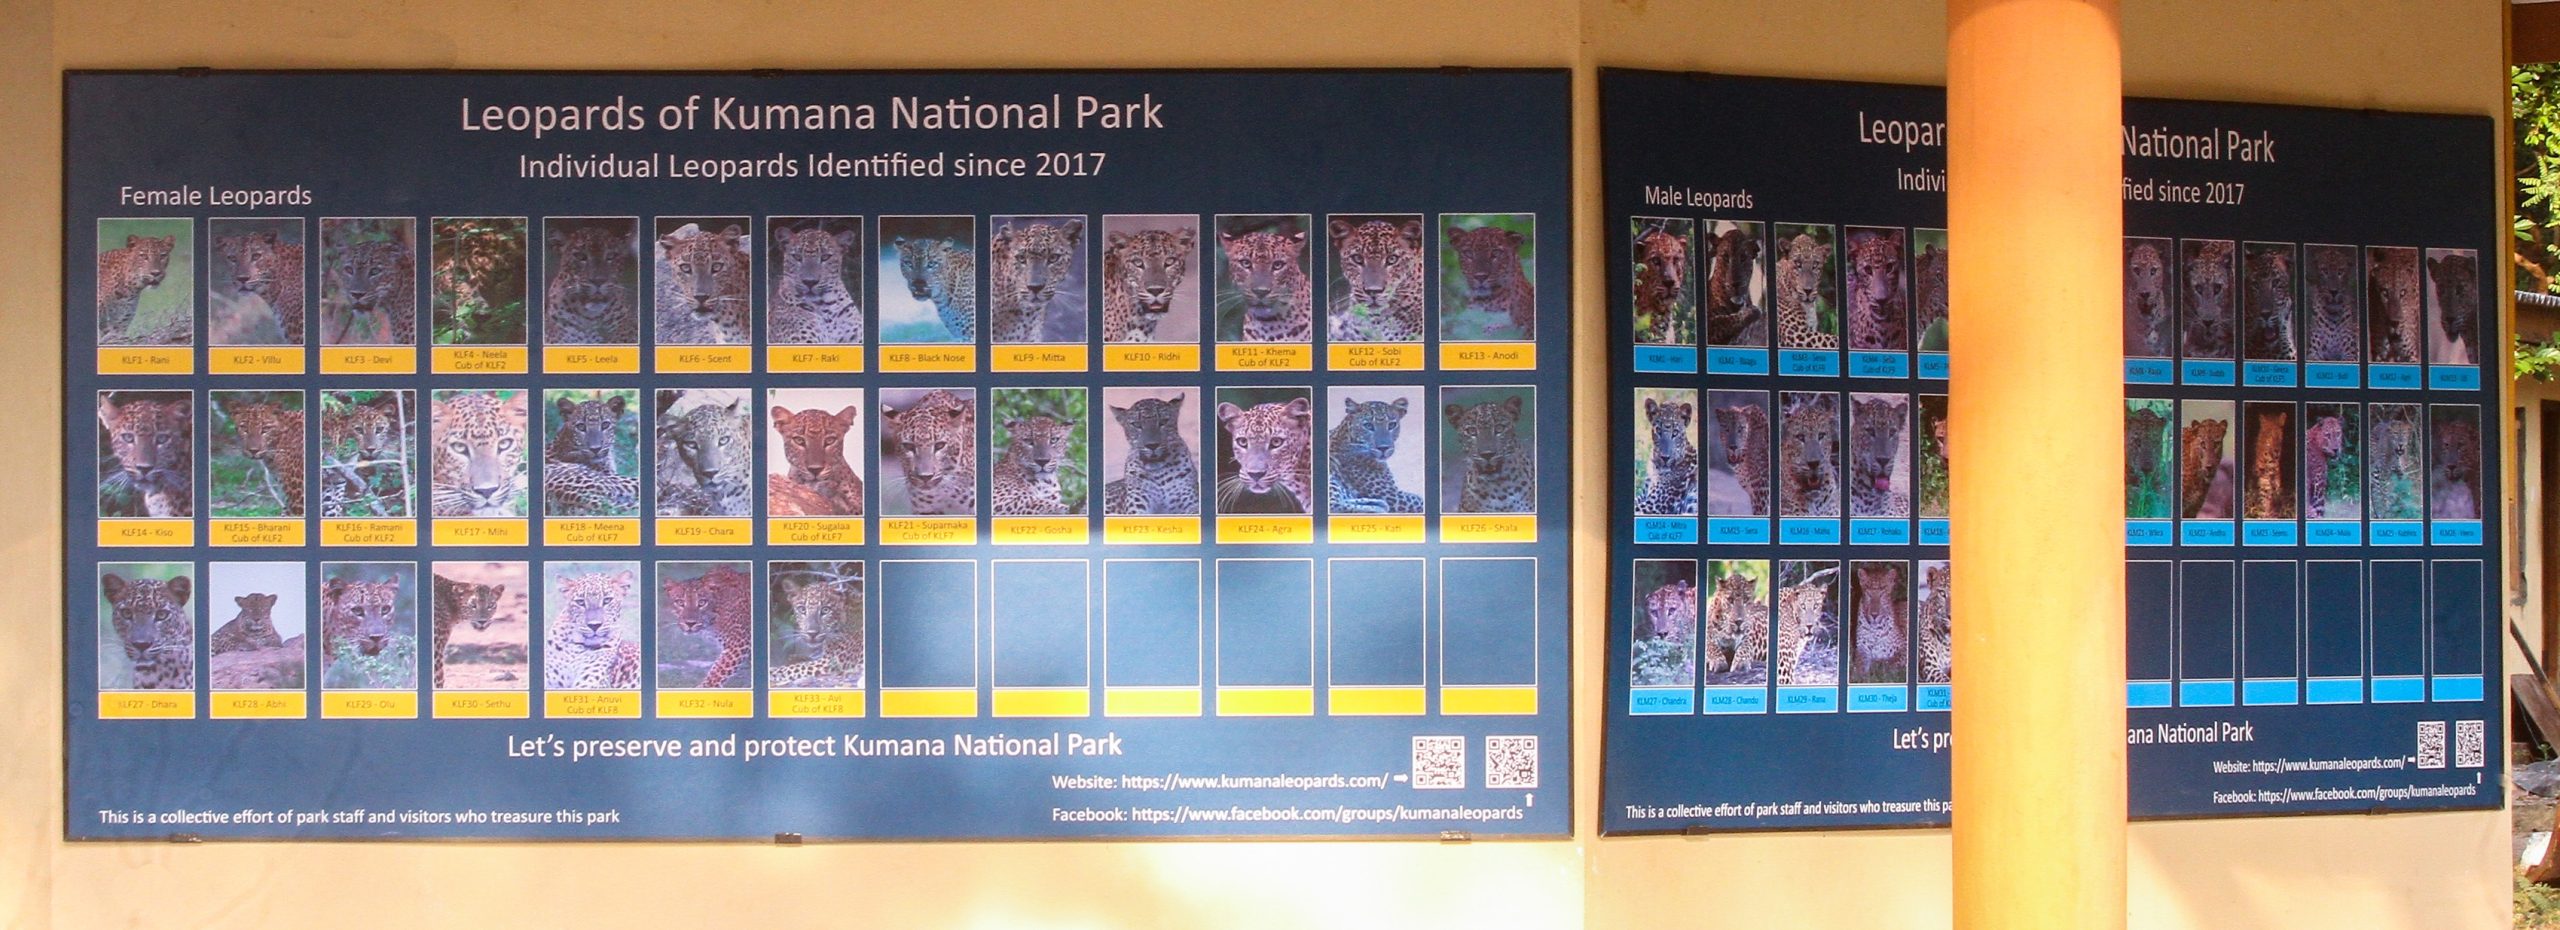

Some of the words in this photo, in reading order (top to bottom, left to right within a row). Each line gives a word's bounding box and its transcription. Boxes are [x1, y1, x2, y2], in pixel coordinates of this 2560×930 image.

[463, 96, 644, 139] Leopards
[659, 95, 700, 130] of
[714, 97, 874, 130] Kumana
[892, 94, 1059, 129] National
[1078, 93, 1163, 128] Park
[1859, 111, 1945, 153] Leopar
[2121, 125, 2219, 160] National
[2228, 130, 2275, 163] Park
[521, 153, 658, 178] Individual
[670, 152, 798, 183] Leopards
[809, 152, 943, 177] Identified
[954, 153, 1026, 177] since
[1036, 153, 1105, 176] 2017
[1898, 168, 1945, 192] Indivi
[2159, 180, 2200, 203] since
[2206, 182, 2244, 205] 2017
[122, 185, 202, 205] Female
[210, 185, 312, 210] Leopards
[1646, 185, 1682, 206] Male
[1687, 187, 1753, 211] Leopards
[454, 350, 474, 359] KLF4
[1232, 348, 1258, 356] KLF11
[1266, 348, 1296, 356] Khema
[1348, 347, 1374, 356] KLF12
[1382, 347, 1401, 355] Sobi
[1459, 351, 1485, 360] KLF13
[1492, 352, 1519, 360] Anodi
[122, 356, 142, 364] KLF1
[150, 356, 170, 364] Rani
[233, 355, 254, 364] KLF2
[345, 355, 365, 364] KLF3
[373, 355, 392, 364] Devi
[567, 355, 587, 363] KLF5
[595, 355, 618, 363] Leela
[679, 354, 700, 363] KLF6
[707, 354, 732, 363] Scent
[792, 354, 813, 363] KLF7
[821, 354, 840, 362] Raki
[889, 353, 910, 362] KLF8
[918, 354, 940, 362] Black
[943, 354, 965, 362] Nose
[1013, 353, 1034, 362] KLF9
[1042, 353, 1066, 362] Mitta
[1124, 352, 1151, 361] KLF10
[1158, 352, 1180, 361] Ridhi
[455, 361, 472, 369] Cub
[474, 361, 483, 369] of
[486, 361, 506, 369] KLF2
[1238, 358, 1256, 367] Cub
[1258, 358, 1267, 367] of
[1269, 358, 1290, 367] KLF2
[1349, 358, 1367, 366] Cub
[1368, 358, 1378, 366] of
[1380, 358, 1400, 366] KLF2
[224, 524, 250, 532] KLF15
[258, 524, 291, 532] Bharani
[336, 523, 362, 532] KLF16
[370, 523, 403, 532] Ramani
[560, 523, 586, 531] KLF18
[594, 523, 625, 531] Meena
[675, 527, 701, 536] KLF19
[708, 527, 734, 535] Chara
[783, 522, 809, 530] KLF20
[817, 522, 850, 532] Sugalaa
[1238, 525, 1264, 533] KLF24
[1272, 525, 1292, 535] Agra
[121, 528, 147, 537] KLF14
[155, 529, 173, 537] Kiso
[232, 534, 249, 543] Cub
[251, 534, 260, 542] of
[263, 534, 283, 542] KLF2
[2128, 728, 2153, 744] ana
[2158, 721, 2217, 743] National
[2223, 720, 2253, 742] Park
[573, 740, 681, 762] preserve
[690, 734, 735, 757] and
[745, 736, 836, 762] protect
[845, 734, 944, 756] Kumana
[955, 733, 1058, 756] National
[1069, 732, 1122, 755] Park
[2213, 760, 2251, 773] Website:
[2253, 755, 2406, 775] https://www.kumanaleopards.com/
[1052, 774, 1117, 789] Website:
[1122, 772, 1389, 791] https://www.kumanaleopards.com/
[2213, 790, 2256, 803] Facebook:
[2258, 783, 2476, 804] https://www.facebook.com/groups/kumanaleopards
[1626, 805, 1646, 818] This
[1648, 805, 1656, 818] is
[1658, 808, 1664, 818] a
[1666, 804, 1713, 818] collective
[1714, 803, 1742, 817] effort
[1744, 802, 1755, 816] of
[1756, 802, 1778, 819] park
[1780, 801, 1802, 815] staff
[1803, 801, 1822, 814] and
[1823, 801, 1857, 814] visitors
[1859, 800, 1880, 813] who
[1882, 801, 1921, 813] treasure
[1923, 798, 1940, 812] this
[99, 810, 129, 823] This
[133, 810, 144, 824] is
[148, 813, 156, 823] a
[160, 809, 229, 824] collective
[233, 809, 274, 823] effort
[277, 809, 293, 823] of
[297, 809, 329, 826] park
[333, 809, 365, 823] staff
[368, 809, 395, 823] and
[399, 810, 451, 823] visitors
[455, 809, 487, 823] who
[491, 811, 552, 823] treasure
[556, 809, 583, 823] this
[587, 809, 620, 826] park
[1053, 807, 1127, 821] Facebook:
[1132, 805, 1523, 824] https://www.facebook.com/groups/kumanaleopards
